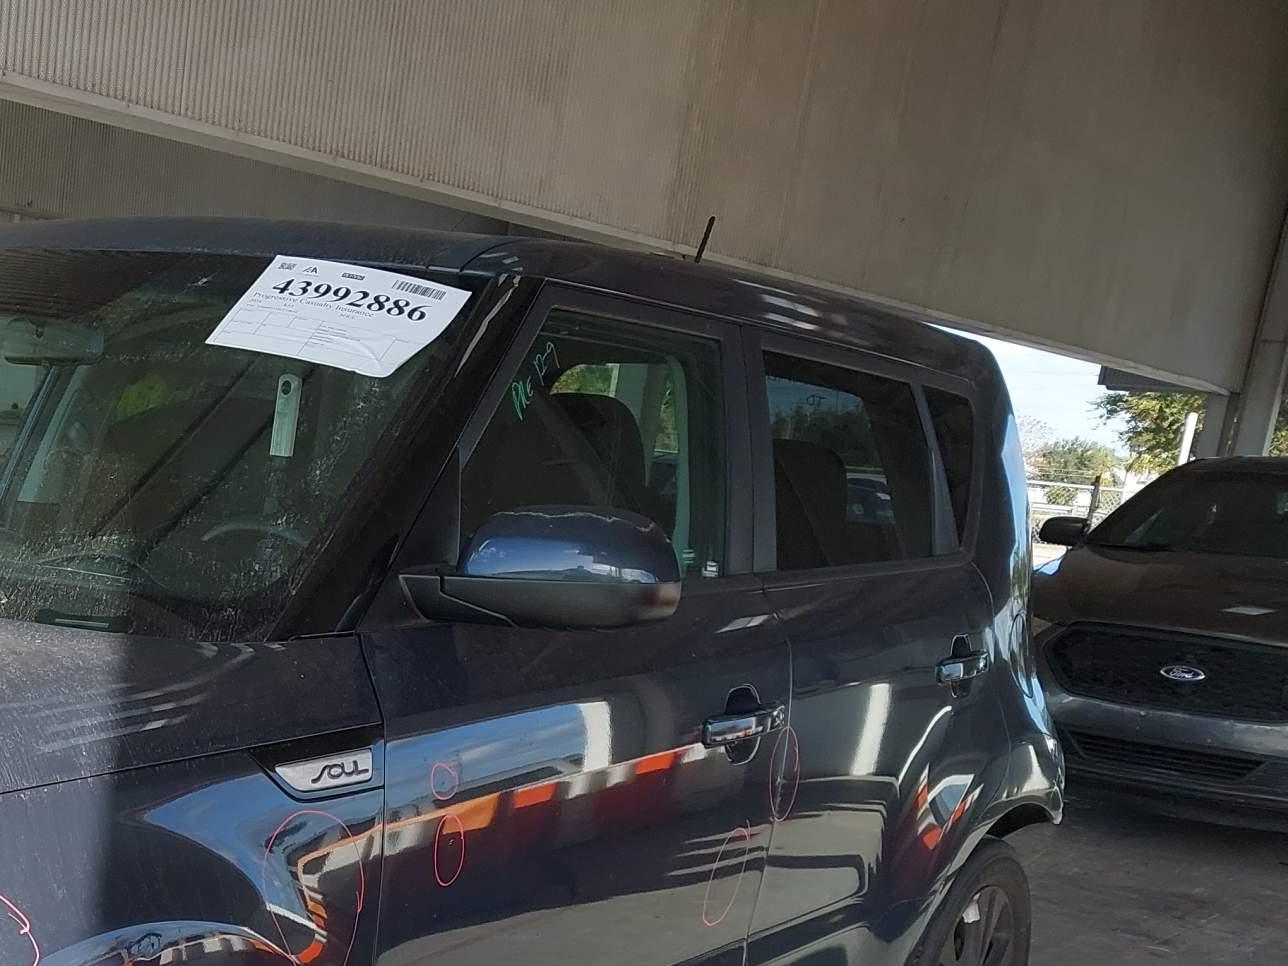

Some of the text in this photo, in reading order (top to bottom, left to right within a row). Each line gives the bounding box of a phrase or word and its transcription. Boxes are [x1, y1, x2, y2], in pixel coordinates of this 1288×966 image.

[253, 291, 298, 304] Progressive
[299, 295, 333, 310] Casualty
[335, 304, 375, 318] Insurance
[272, 278, 433, 322] 43992886
[311, 760, 370, 784] SOUL
